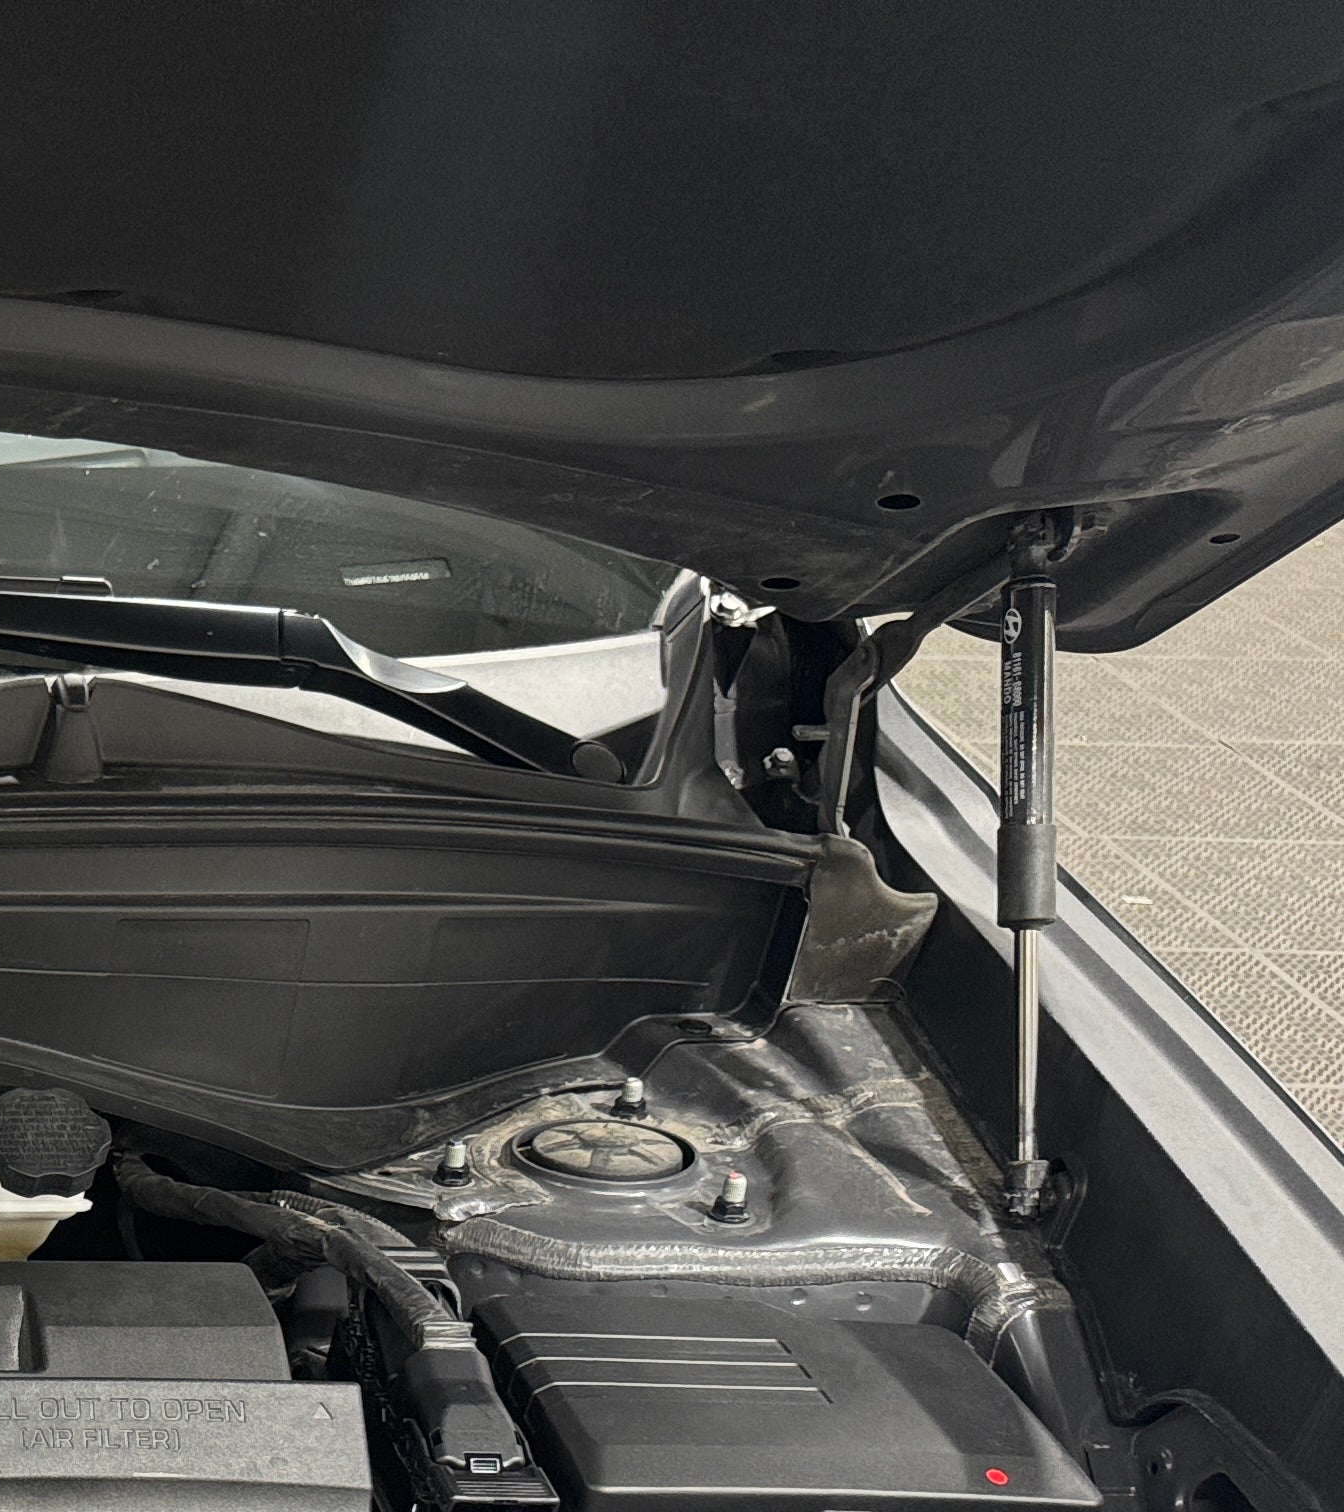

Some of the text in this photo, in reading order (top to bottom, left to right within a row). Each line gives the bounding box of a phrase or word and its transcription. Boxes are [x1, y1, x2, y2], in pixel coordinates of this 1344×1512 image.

[1002, 660, 1013, 705] MANDO
[38, 1397, 101, 1422] OUT
[109, 1397, 153, 1422] TO
[160, 1398, 247, 1424] OPEN
[81, 1428, 182, 1453] FILTER)
